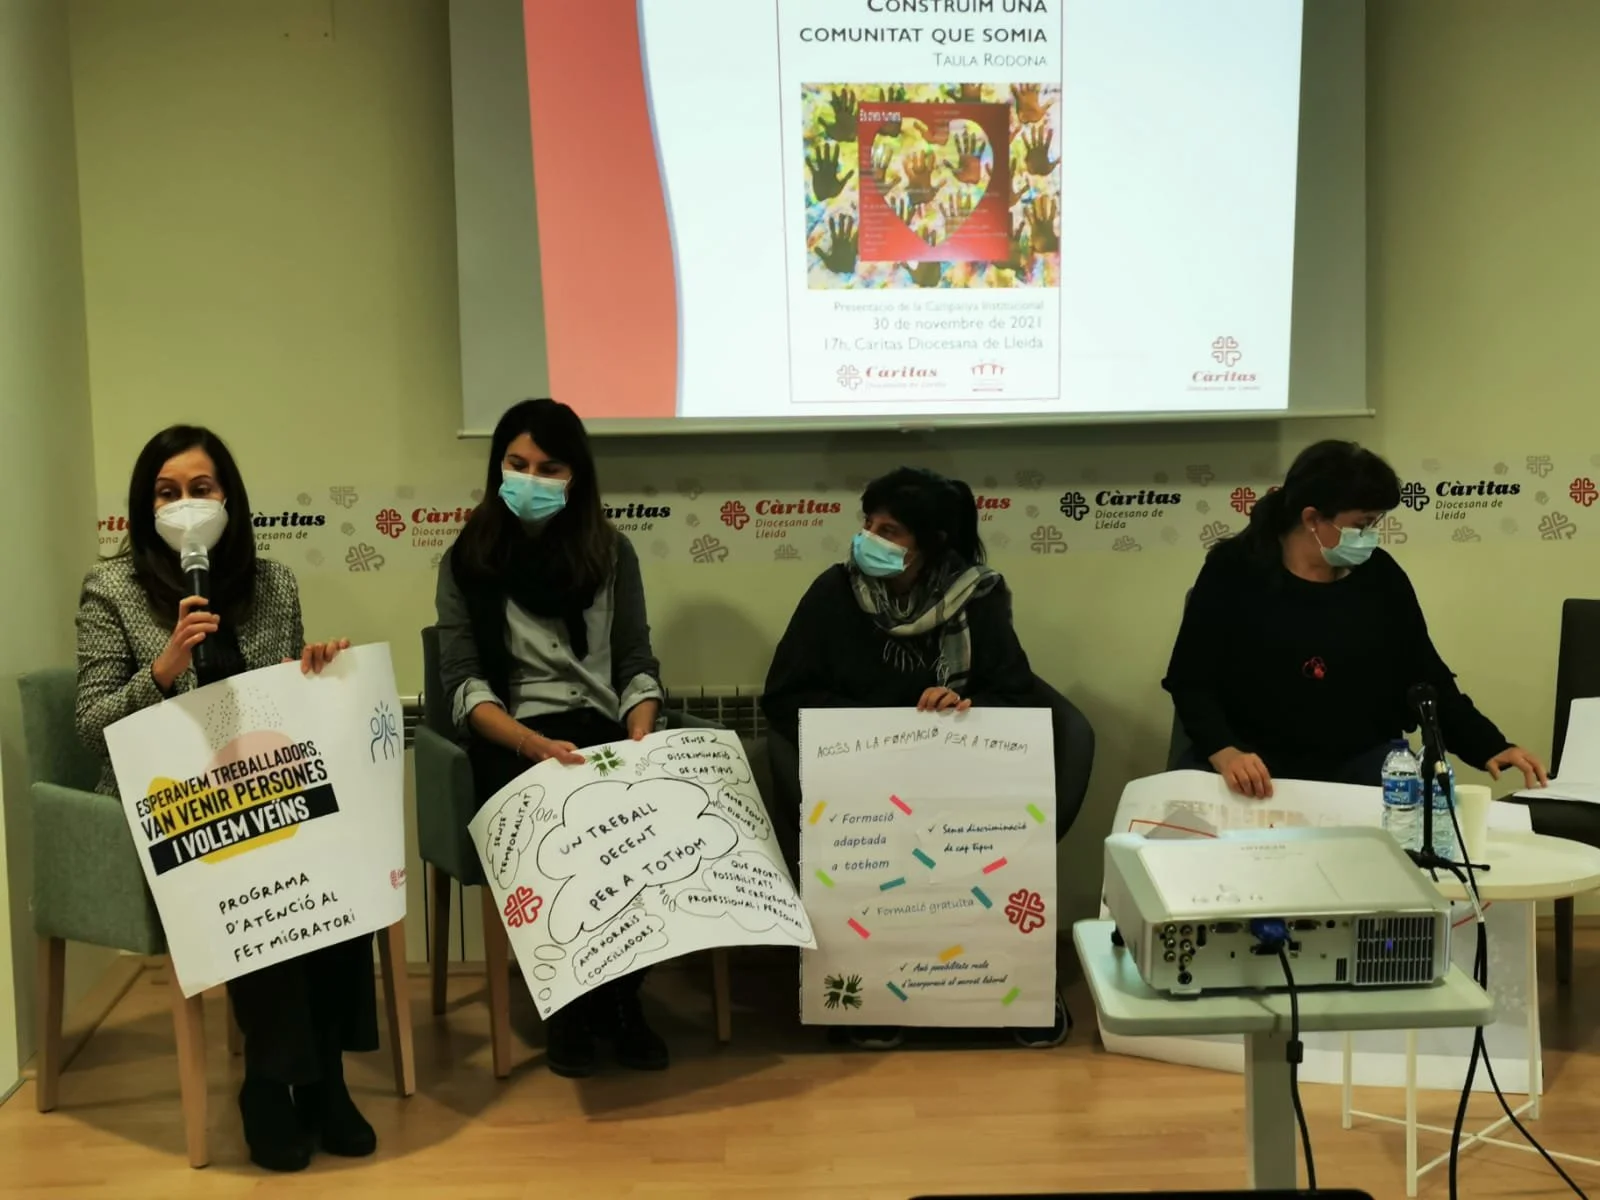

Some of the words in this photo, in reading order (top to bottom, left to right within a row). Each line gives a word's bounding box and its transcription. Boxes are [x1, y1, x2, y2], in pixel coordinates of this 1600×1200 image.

[1003, 0, 1048, 13] UNA
[799, 28, 923, 42] COMUNITAT
[931, 28, 975, 45] QUE
[982, 28, 1048, 42] SOMIA
[898, 301, 912, 312] de
[873, 317, 890, 330] 30
[894, 317, 911, 330] de
[916, 316, 984, 330] novembre
[989, 315, 1006, 329] de
[1011, 315, 1042, 329] 2021
[908, 336, 978, 351] Diocesana
[983, 336, 999, 350] de
[1004, 335, 1044, 350] Lleida
[1435, 480, 1521, 498] Càritas
[1095, 489, 1182, 507] Càritas
[1435, 498, 1489, 510] Diocesana
[1491, 498, 1504, 509] de
[603, 502, 671, 519] àritas
[755, 498, 842, 516] Càritas
[1095, 508, 1149, 520] Diocesana
[1151, 508, 1164, 519] de
[249, 511, 326, 527] àritas
[411, 507, 472, 524] Càrit
[755, 517, 809, 529] Diocesana
[811, 517, 824, 528] de
[1435, 510, 1467, 521] Lleida
[412, 526, 460, 537] Diocesan
[1095, 520, 1127, 531] Lleida
[295, 529, 308, 540] de
[755, 528, 787, 540] Lleida
[412, 537, 443, 547] Lleida
[855, 740, 862, 752] A
[866, 736, 879, 749] LA
[944, 732, 967, 746] PER
[971, 735, 979, 748] A
[211, 740, 322, 786] TREBALLADORS,
[141, 810, 177, 842] VAN
[176, 788, 233, 826] VENIR
[233, 758, 329, 806] PERSONES
[842, 812, 895, 824] Formació
[493, 817, 507, 847] SENSE
[500, 793, 532, 874] TEMPORALITAT
[560, 836, 583, 856] UN
[586, 802, 658, 839] TREBALL
[943, 823, 964, 834] Sense
[172, 840, 183, 864] I
[182, 818, 250, 859] VOLEM
[599, 825, 657, 866] DECENT
[833, 833, 887, 848] adaptada
[944, 842, 953, 852] de
[955, 845, 969, 854] cap
[731, 860, 749, 870] QUE
[831, 863, 838, 872] a
[845, 857, 890, 870] tothom
[589, 886, 620, 912] PER
[623, 873, 635, 888] A
[642, 838, 707, 875] TOTHOM
[219, 872, 310, 915] PROGRAMA
[321, 891, 339, 906] AL
[877, 902, 927, 915] Formació
[234, 942, 264, 962] FET
[579, 947, 599, 967] AMB
